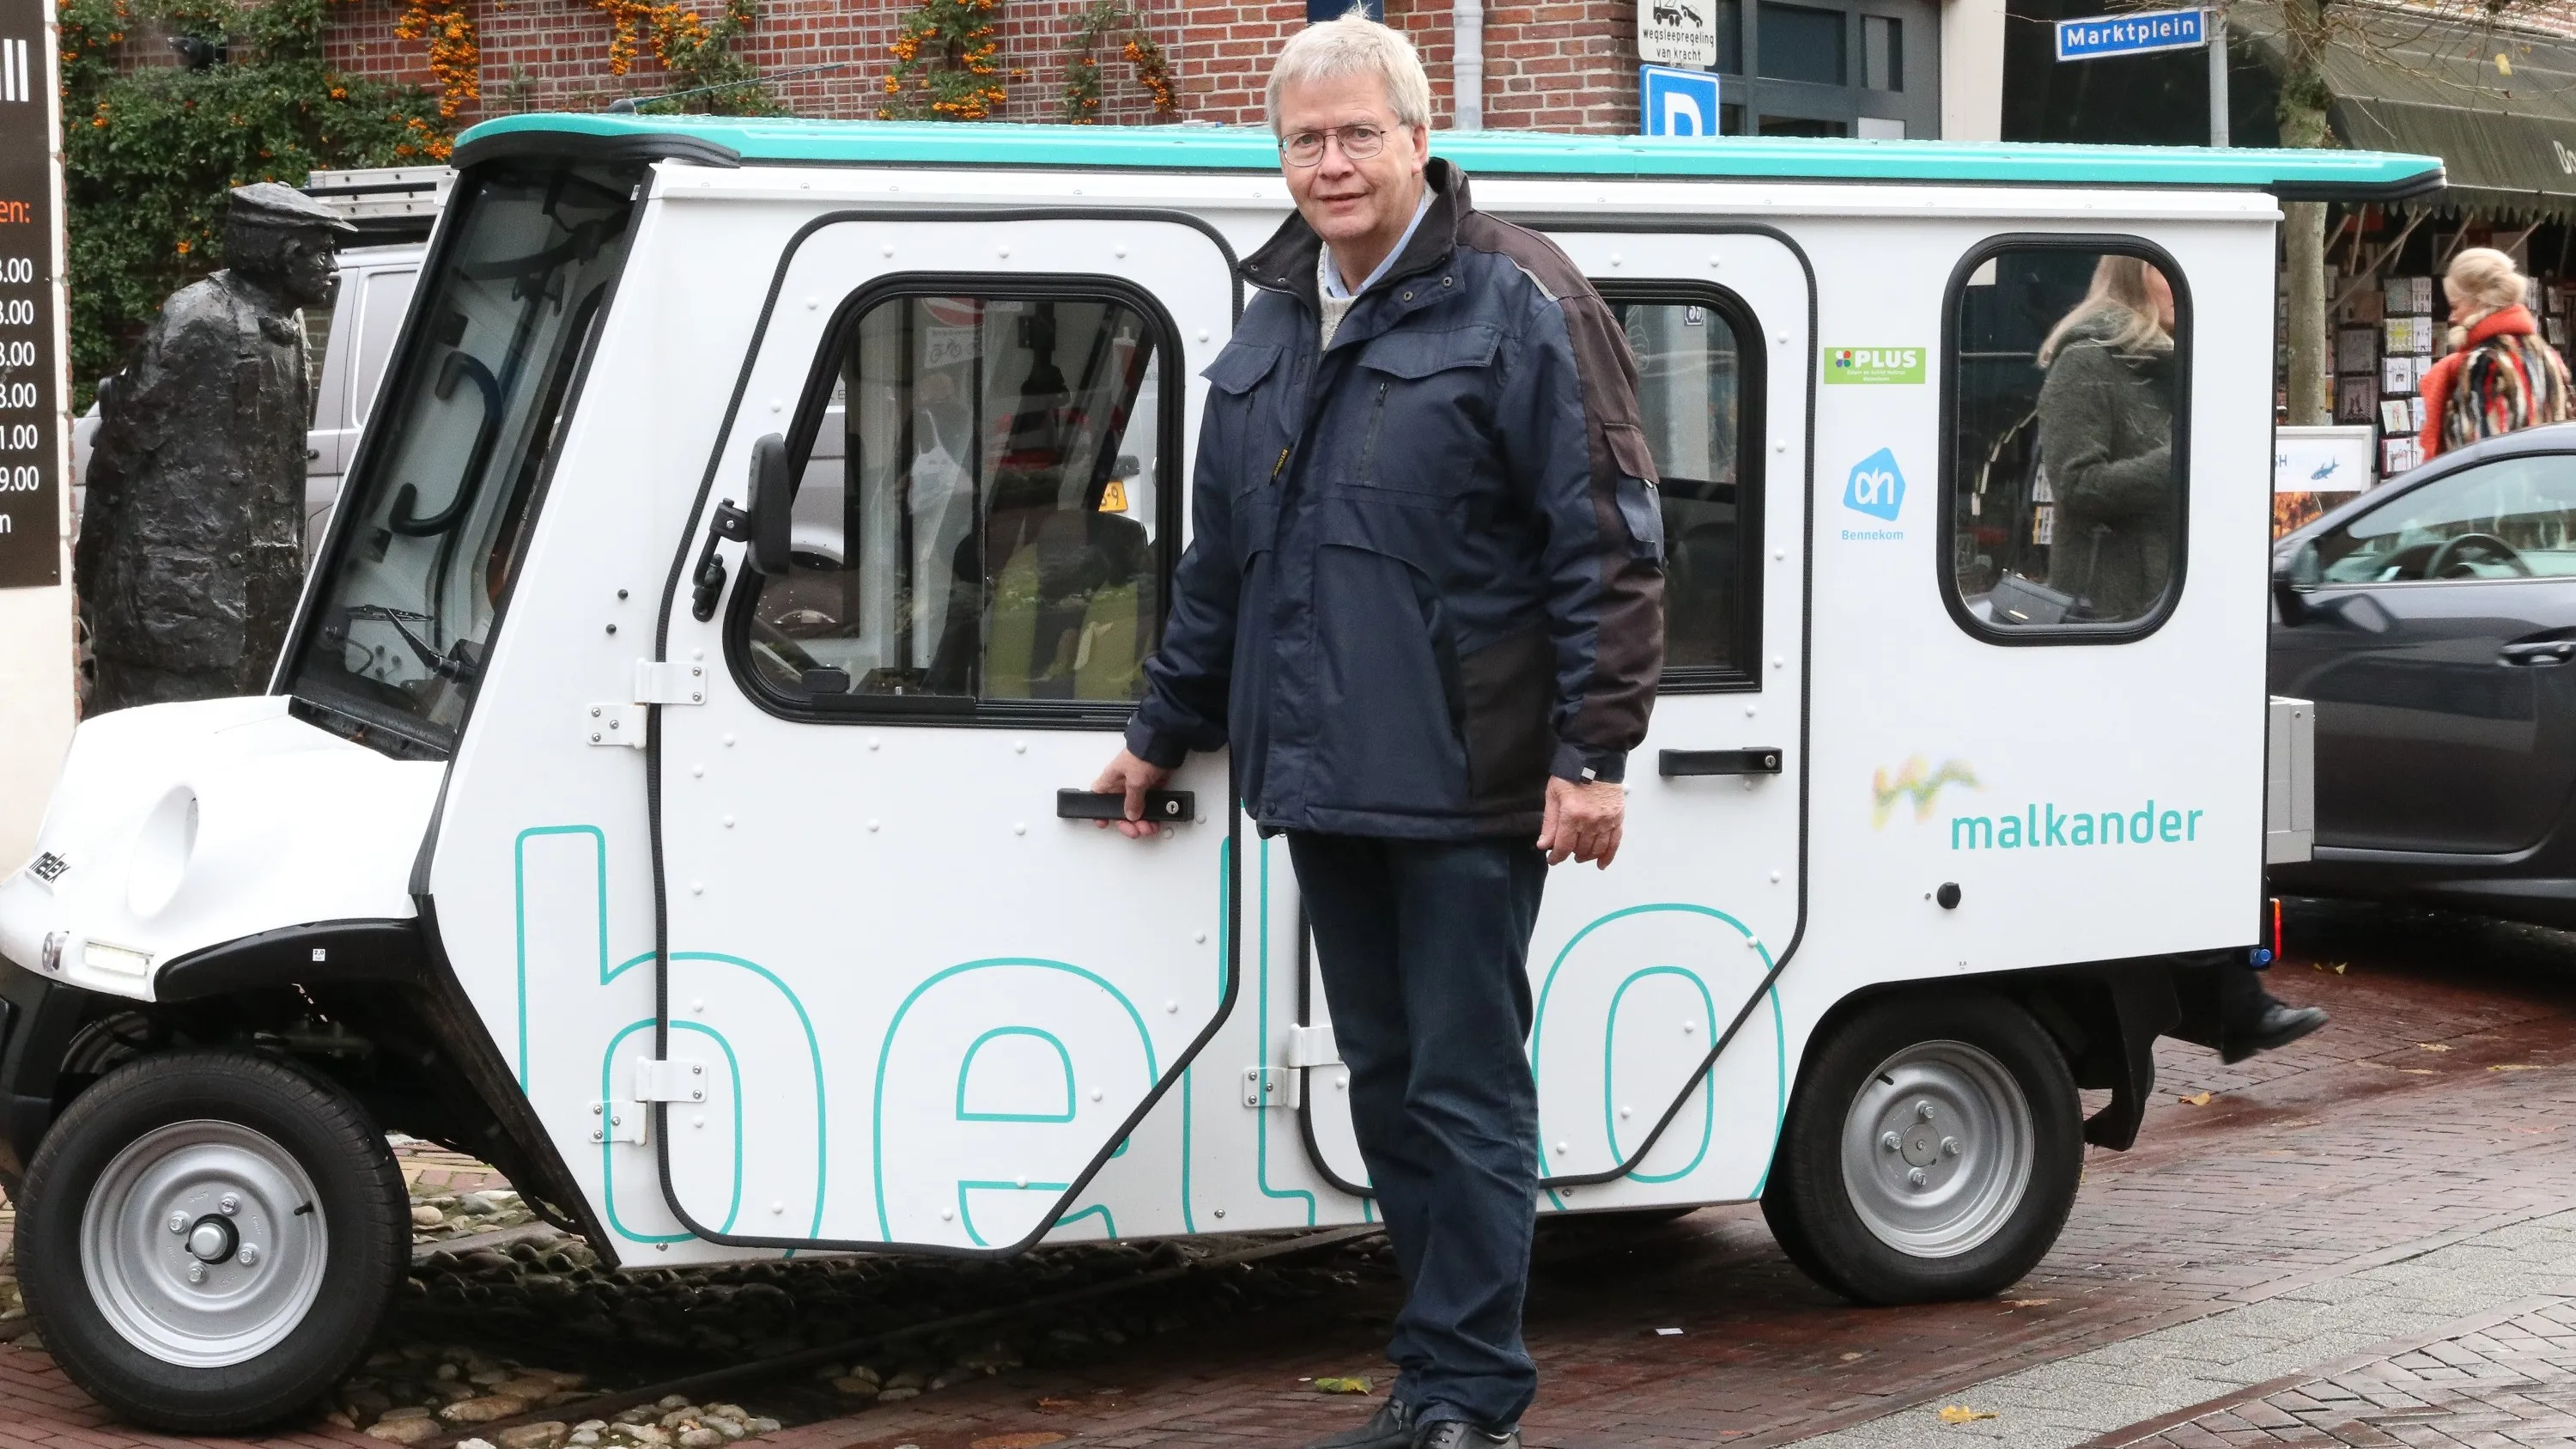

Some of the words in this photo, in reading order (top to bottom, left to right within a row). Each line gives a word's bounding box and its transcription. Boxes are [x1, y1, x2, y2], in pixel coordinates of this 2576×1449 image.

[1643, 27, 1715, 47] wegsleepregeling
[2067, 18, 2195, 46] Marktplein
[1656, 47, 1671, 58] van
[1674, 47, 1702, 61] kracht
[1855, 350, 1917, 368] PLUS
[1841, 529, 1904, 540] Bennekom
[1951, 800, 2203, 850] malkander
